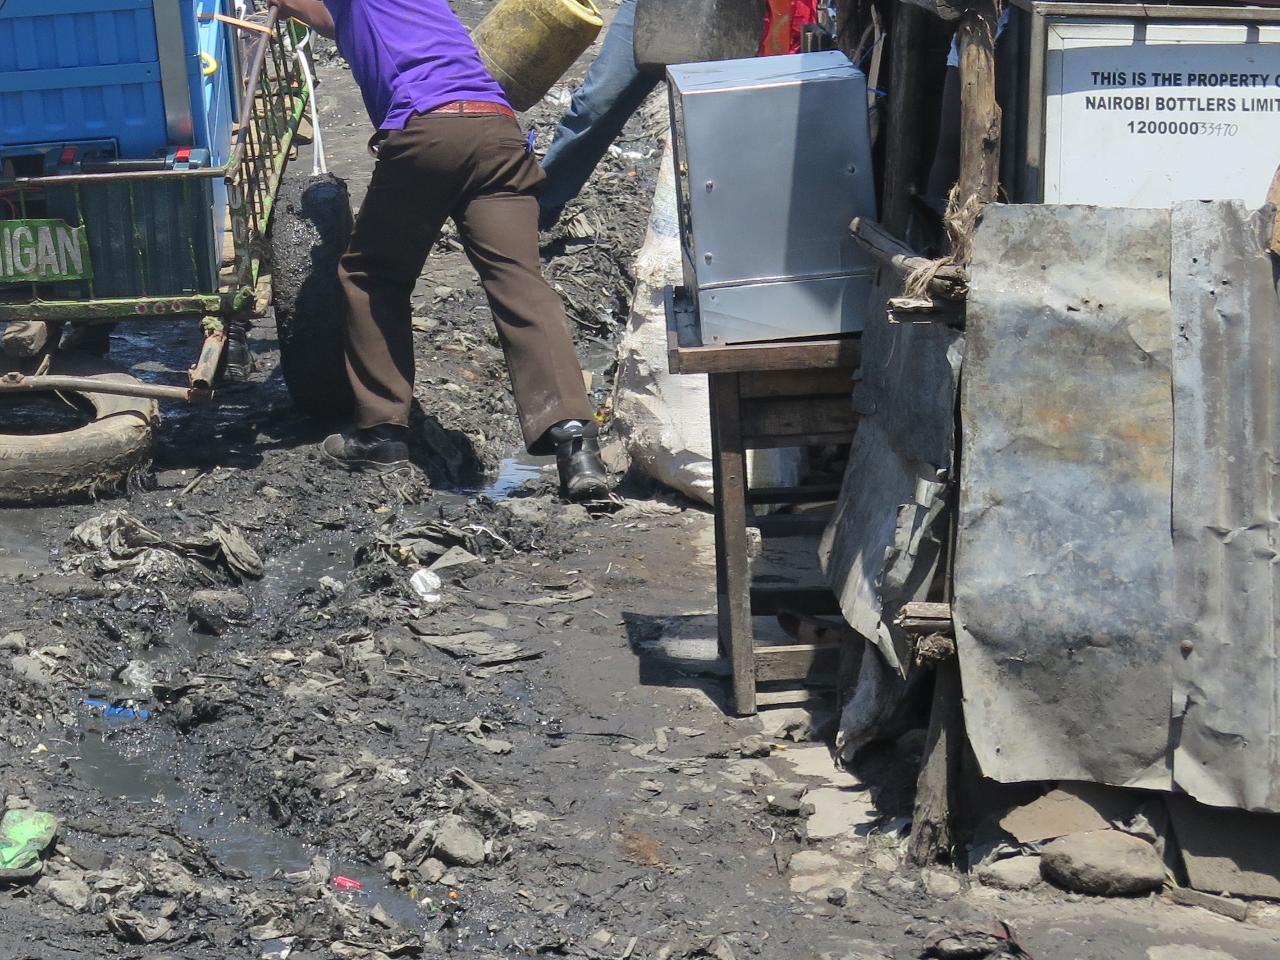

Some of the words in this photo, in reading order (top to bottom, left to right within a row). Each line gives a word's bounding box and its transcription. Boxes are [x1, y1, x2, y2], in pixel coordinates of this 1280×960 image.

[1091, 71, 1127, 86] THIS
[1132, 72, 1147, 86] IS
[1151, 72, 1183, 87] THE
[1187, 73, 1270, 88] PROPERTY
[1085, 96, 1150, 111] NAIROBI
[1155, 97, 1236, 112] BOTTLERS
